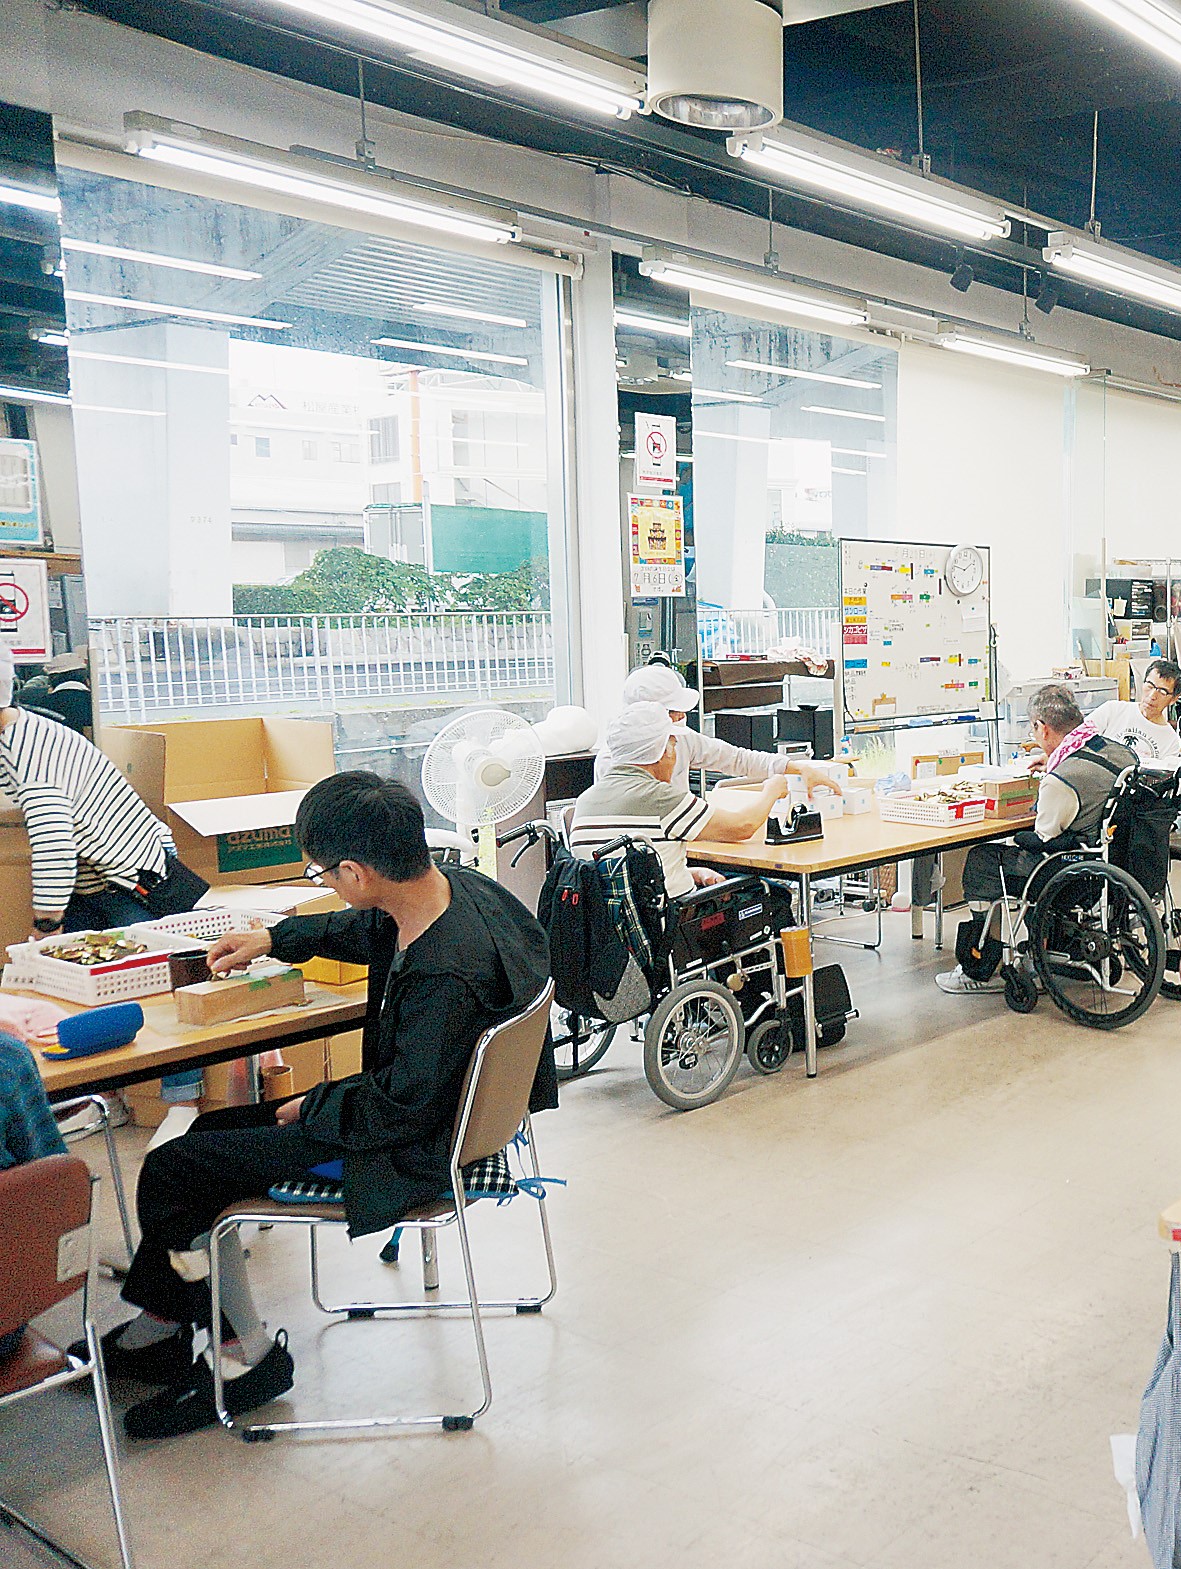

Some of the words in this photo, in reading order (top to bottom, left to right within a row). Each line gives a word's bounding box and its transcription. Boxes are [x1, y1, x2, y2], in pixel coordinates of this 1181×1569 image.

[844, 606, 867, 615] サンロール
[225, 826, 292, 845] azuma
